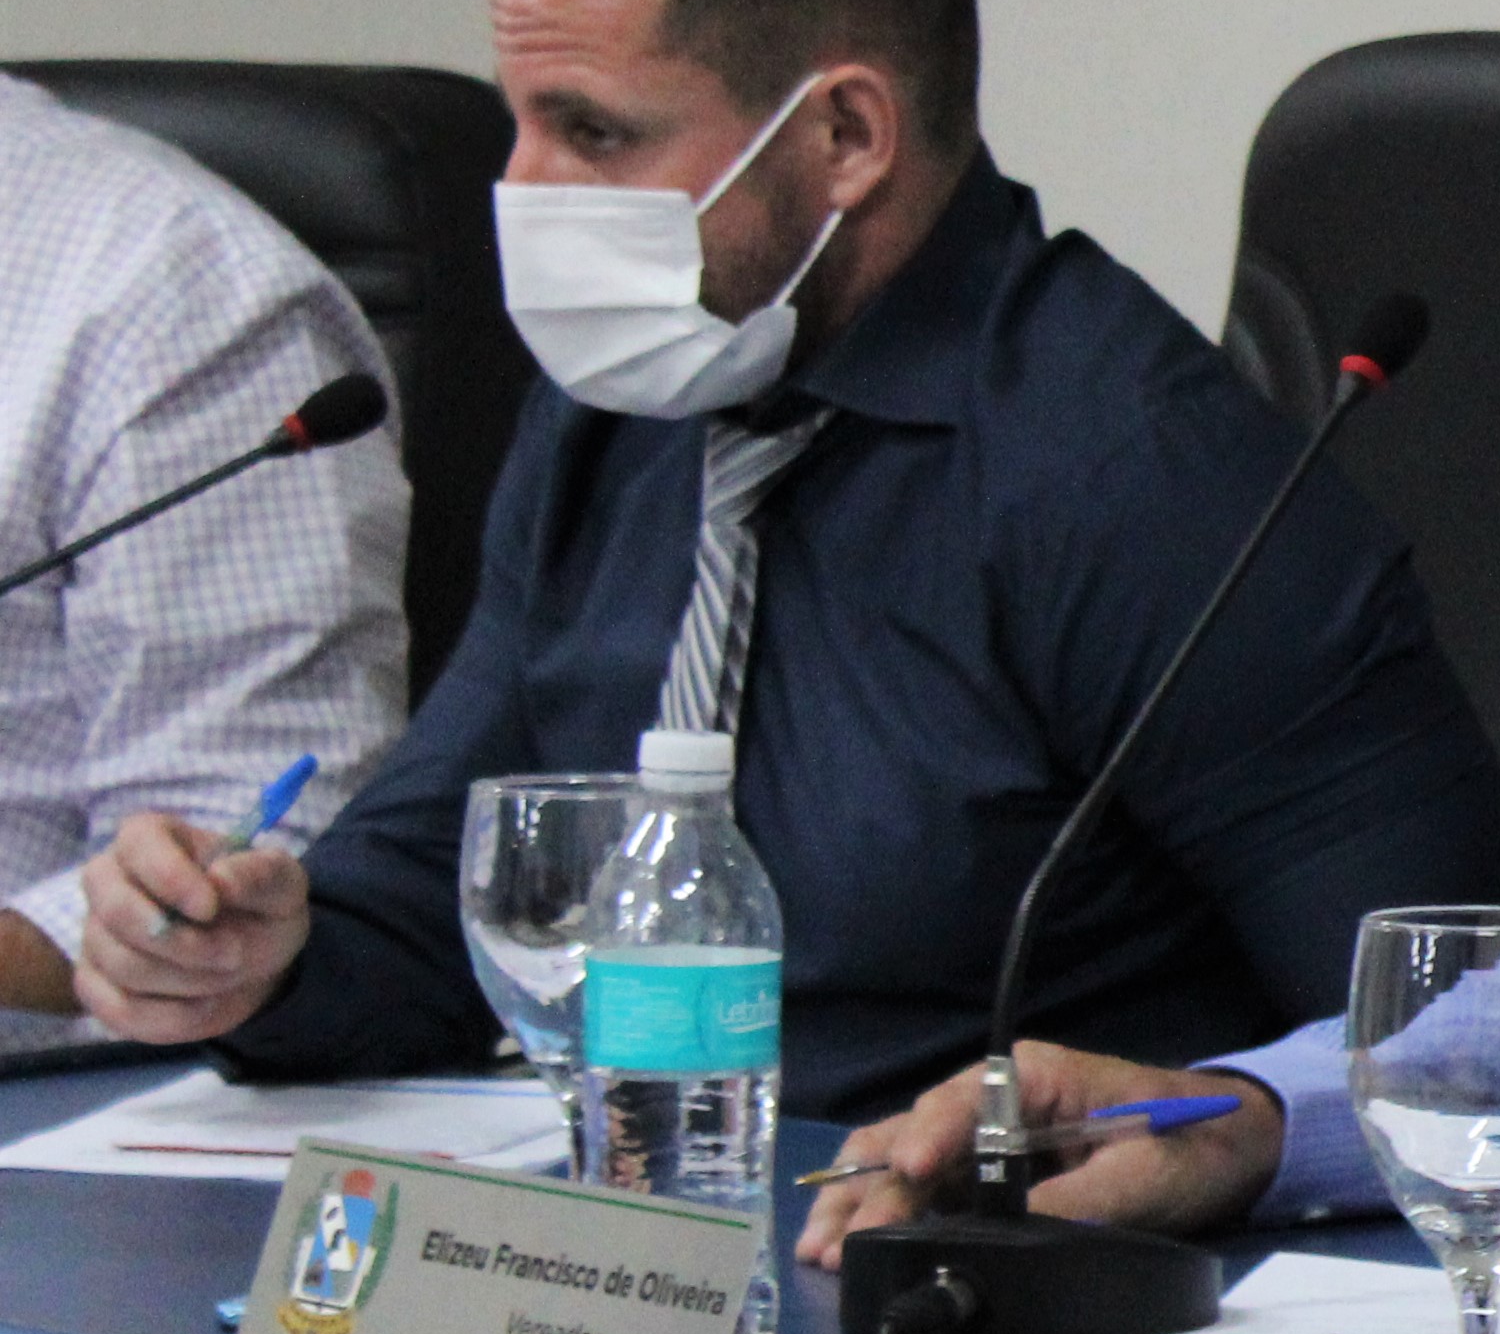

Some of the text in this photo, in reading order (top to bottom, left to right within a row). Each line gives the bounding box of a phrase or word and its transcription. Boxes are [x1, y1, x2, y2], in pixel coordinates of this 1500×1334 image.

[420, 1229, 728, 1316] Elizeu Francisco de Oliveira
